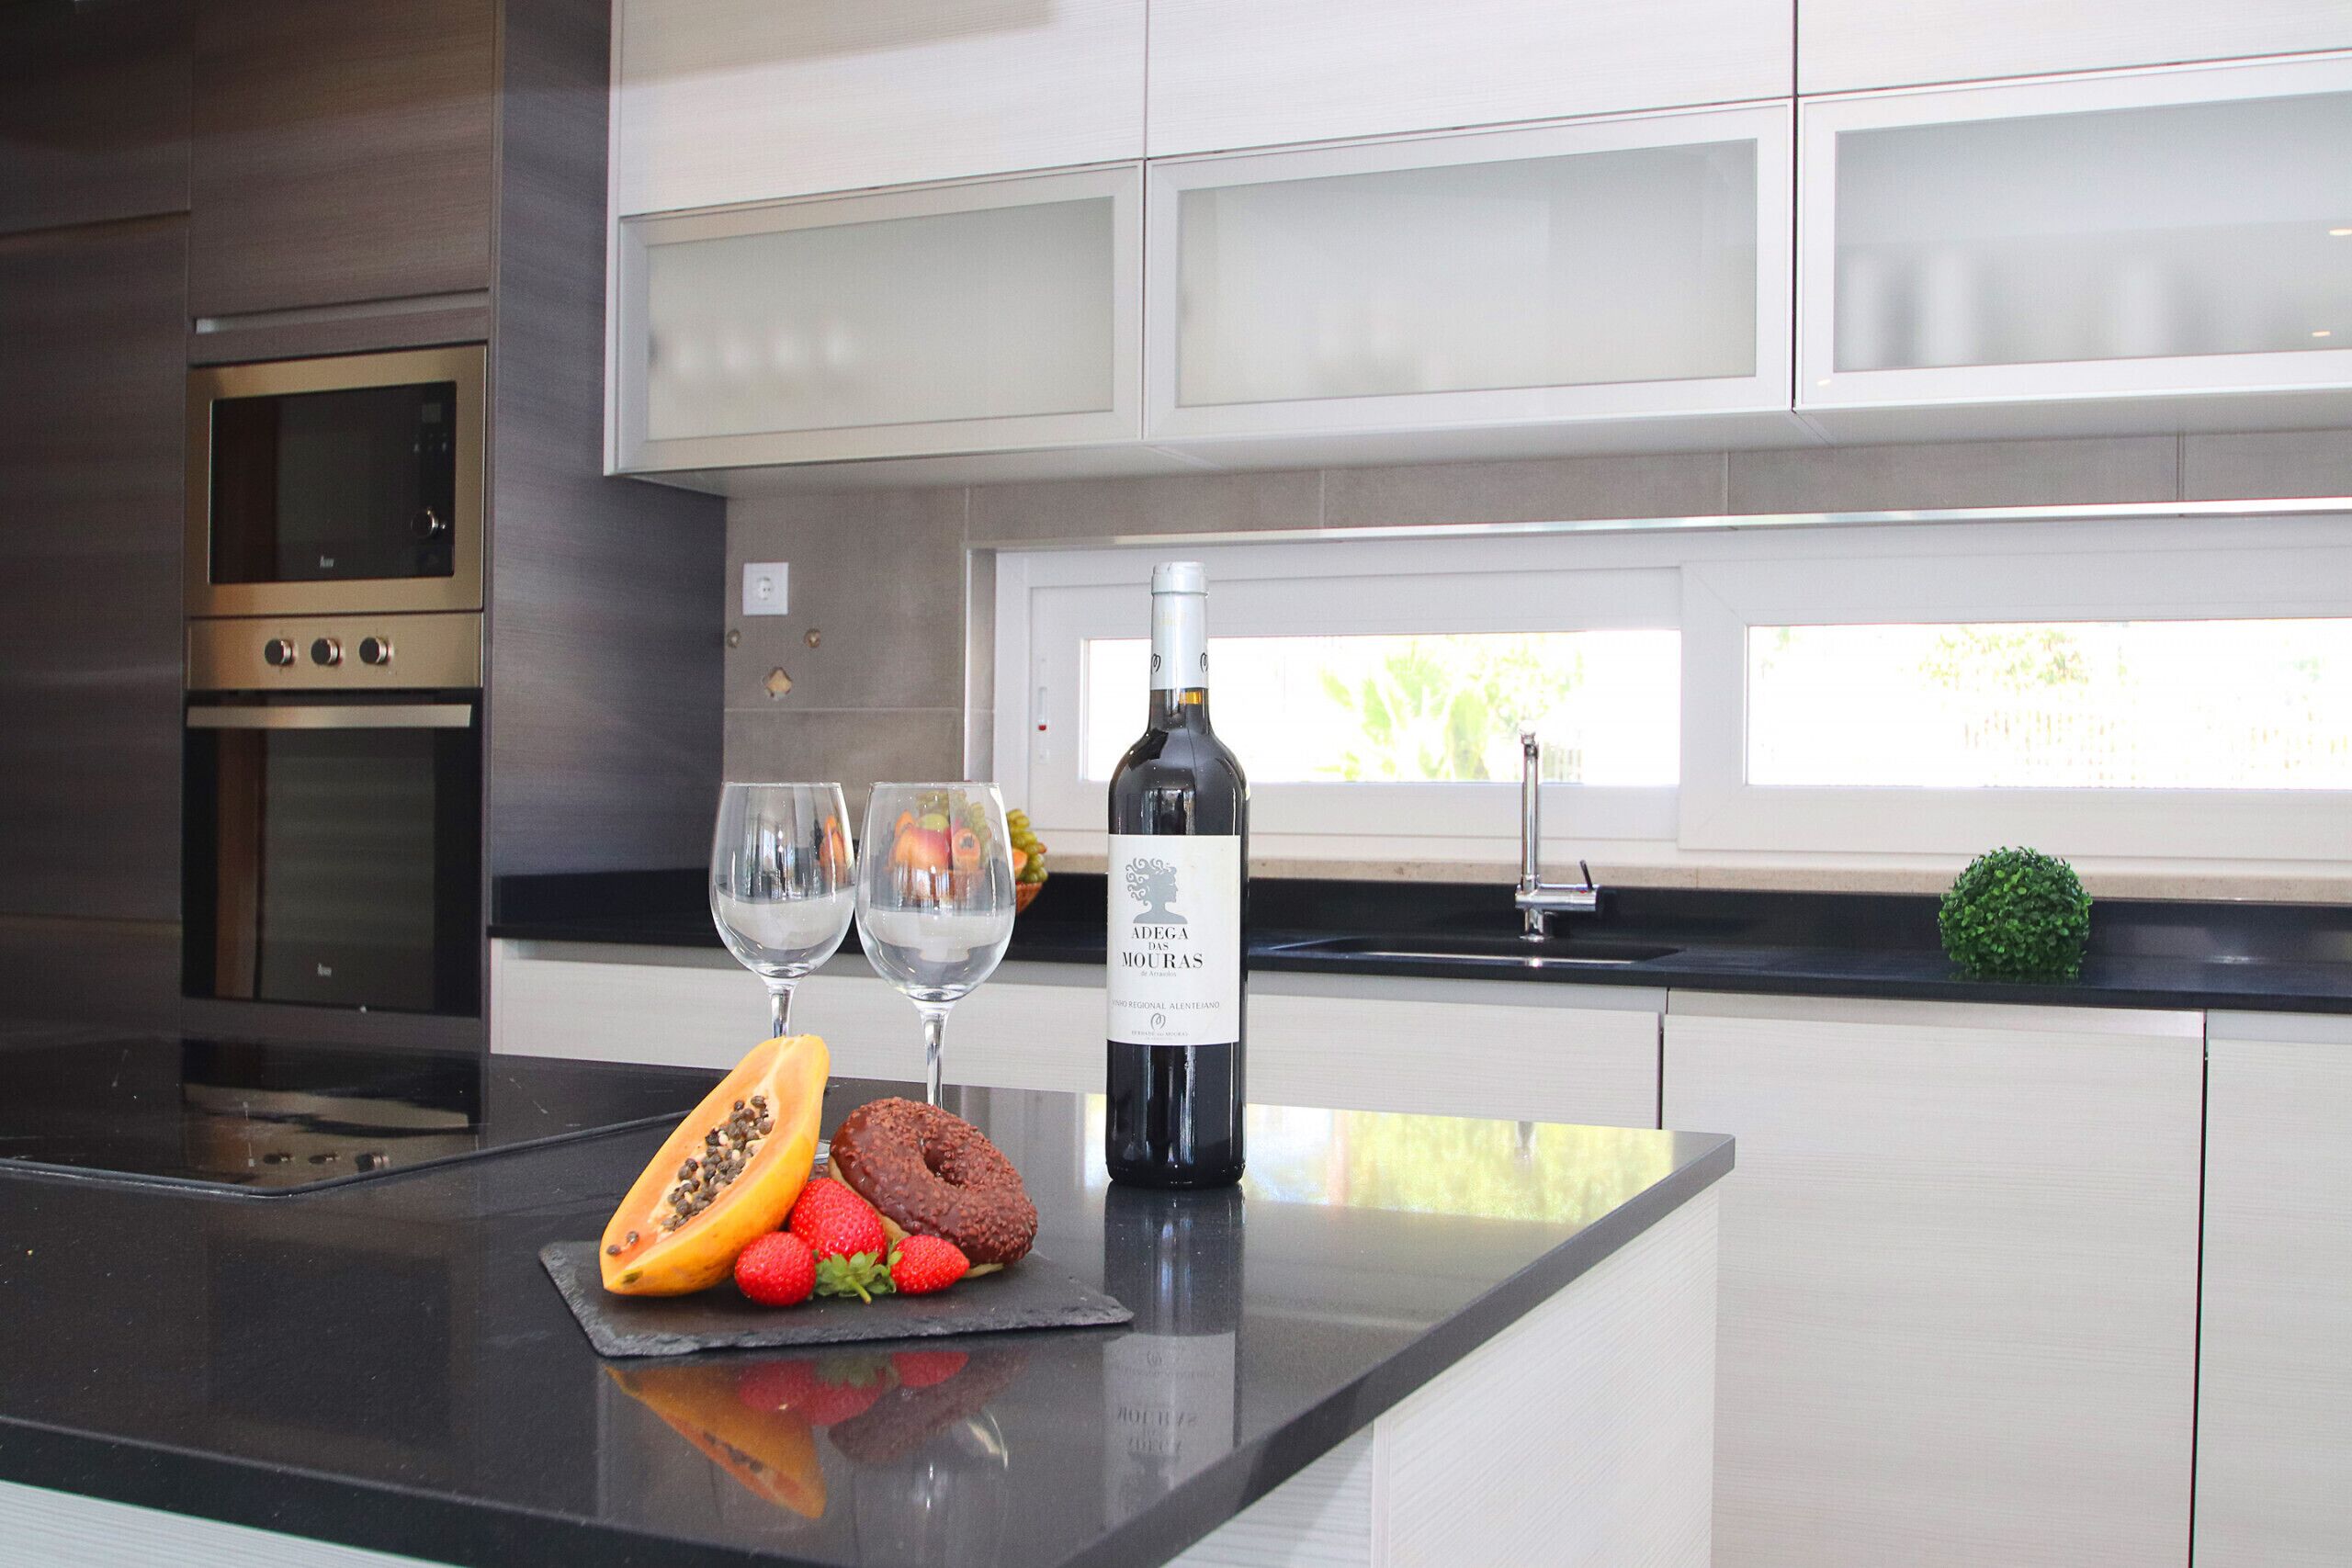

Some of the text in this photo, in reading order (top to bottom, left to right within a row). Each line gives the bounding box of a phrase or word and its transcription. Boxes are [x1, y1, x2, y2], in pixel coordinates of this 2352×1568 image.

[1132, 927, 1189, 940] ADEGA
[1148, 942, 1169, 951] DAS
[1122, 952, 1204, 969] MOURAS
[1128, 1000, 1166, 1010] REGIONAL
[1170, 1000, 1220, 1010] ALENTEJANO
